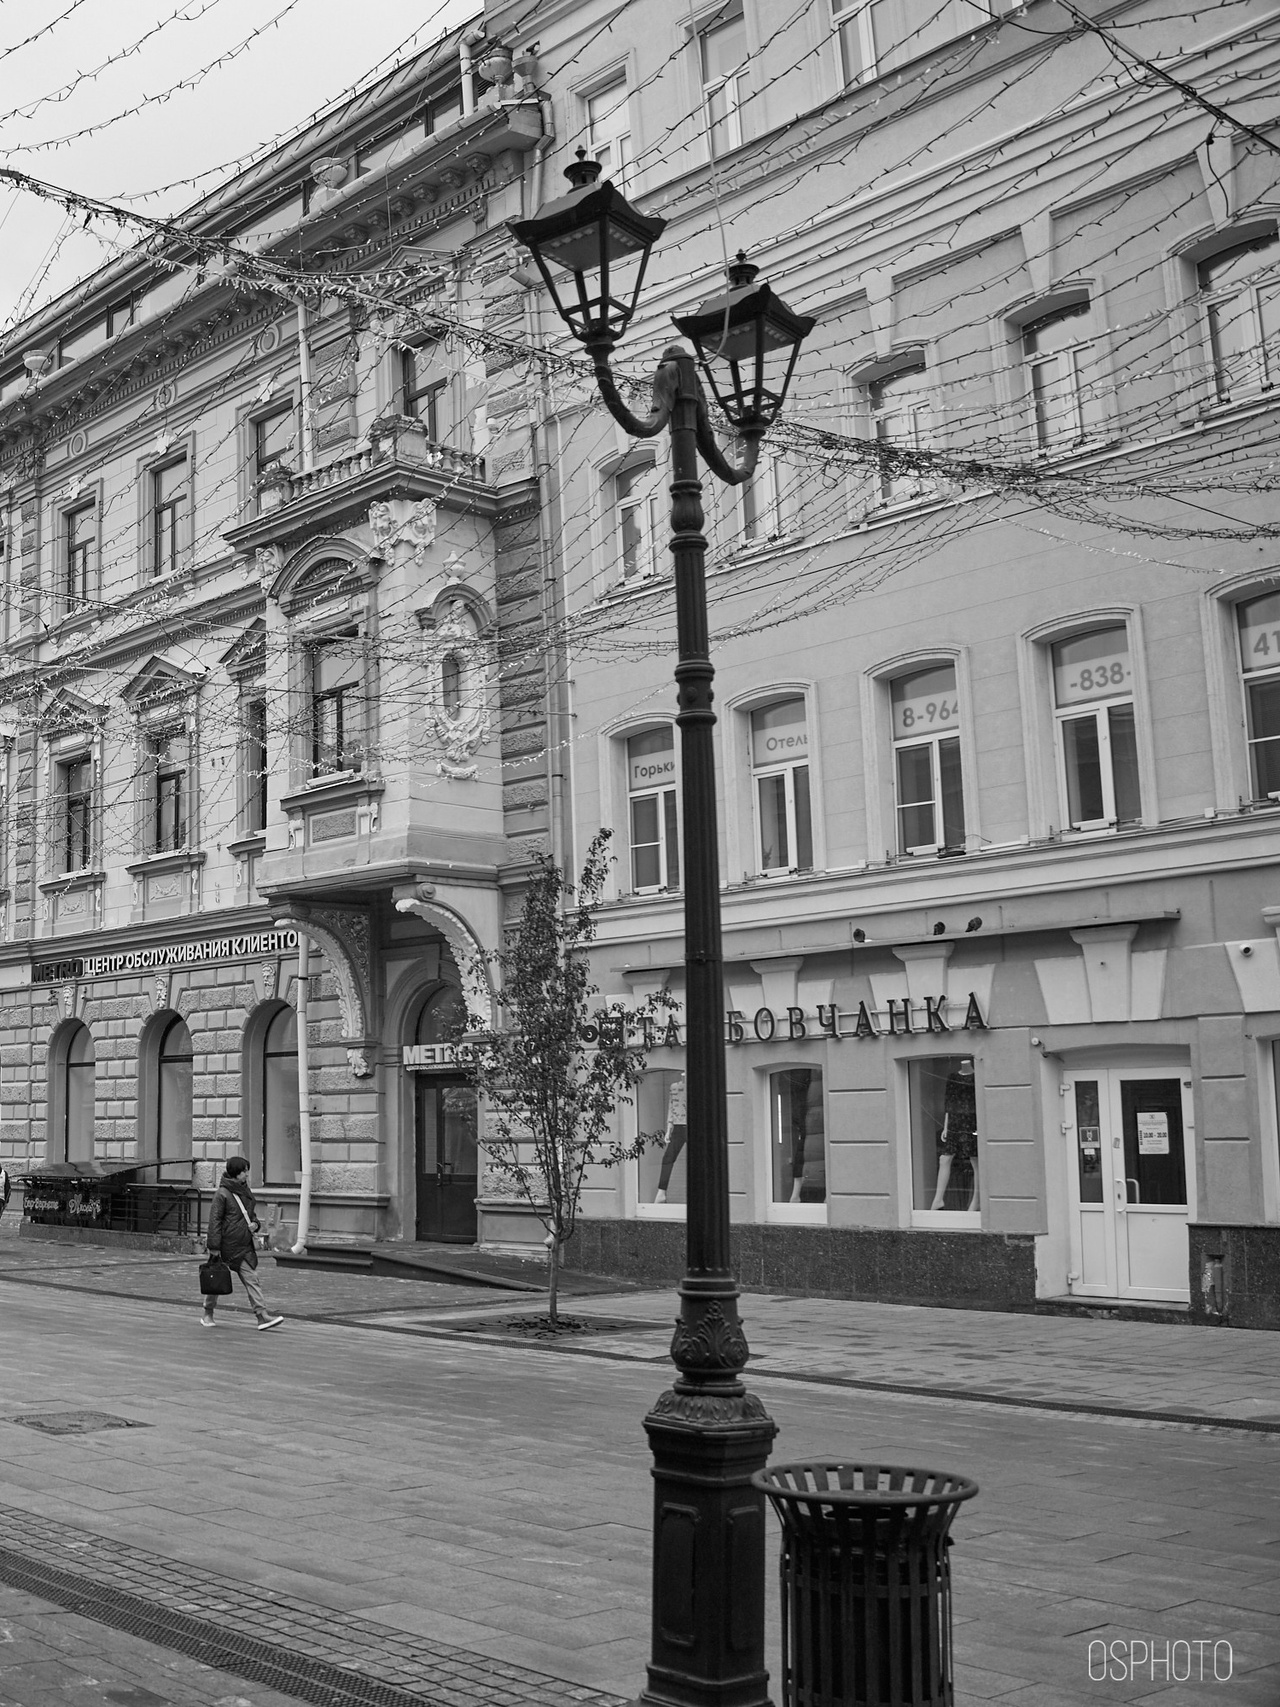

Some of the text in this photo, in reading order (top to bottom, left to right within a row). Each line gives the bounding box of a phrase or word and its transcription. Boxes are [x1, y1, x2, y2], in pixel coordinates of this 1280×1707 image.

[31, 959, 82, 983] METRO
[87, 953, 124, 977] ЦЕНТР
[126, 939, 230, 970] ОБСЛУЖИВАНИЯ
[637, 991, 991, 1048] ТАБОВЧАНКА
